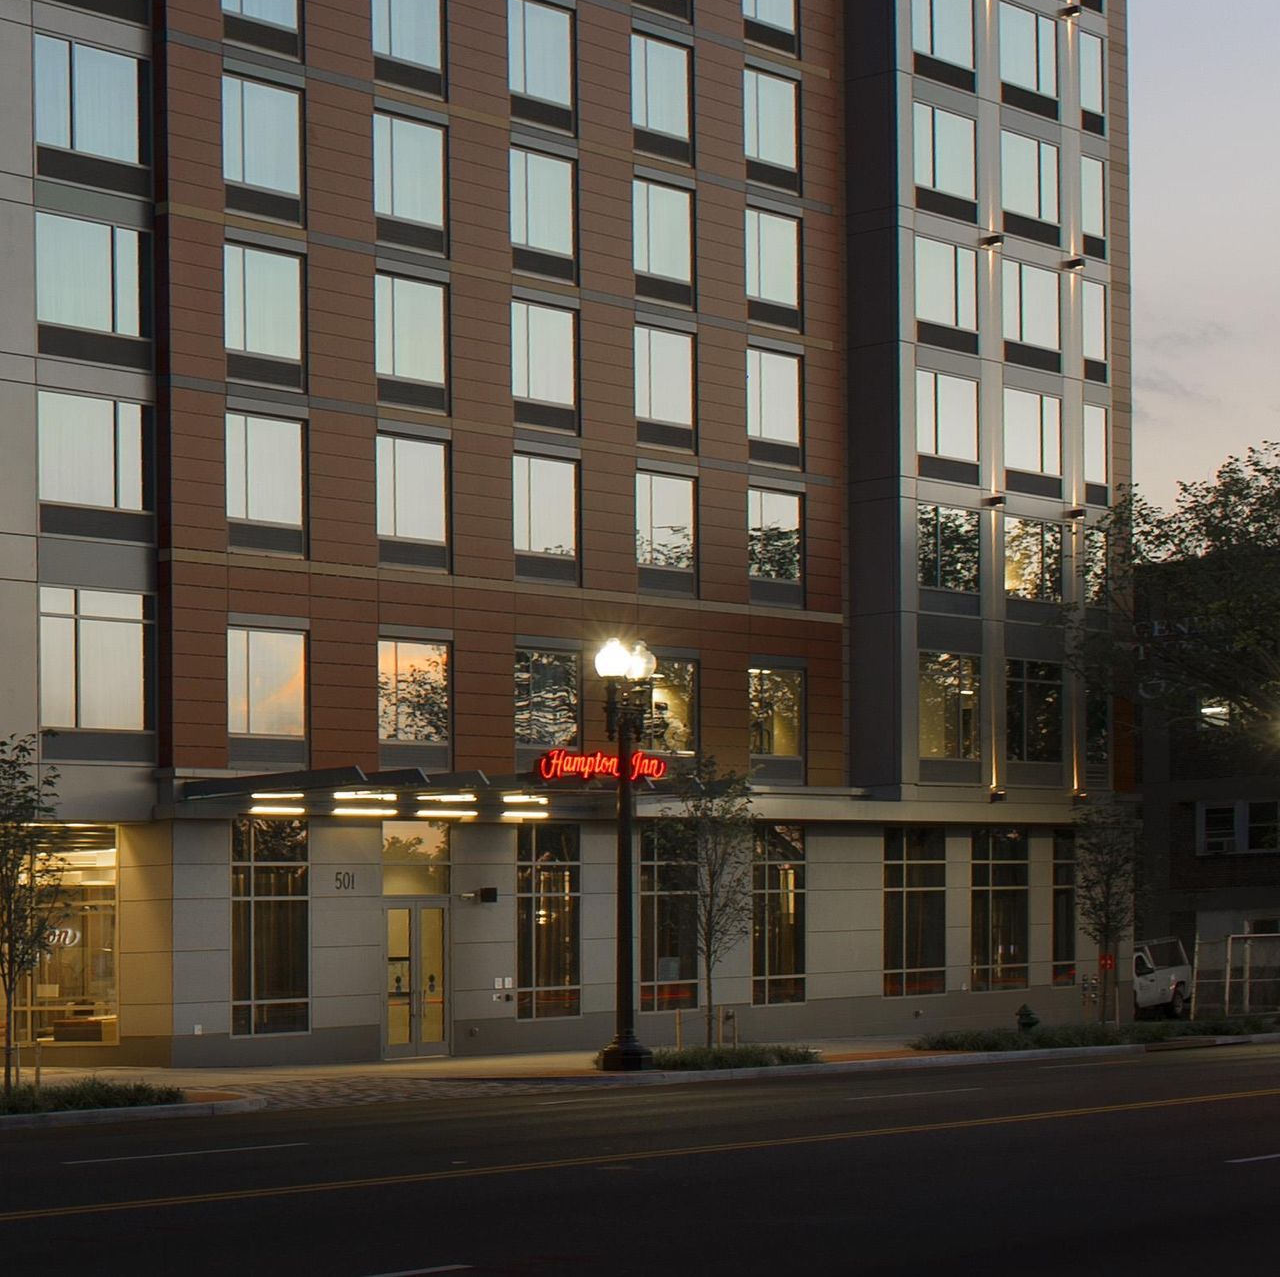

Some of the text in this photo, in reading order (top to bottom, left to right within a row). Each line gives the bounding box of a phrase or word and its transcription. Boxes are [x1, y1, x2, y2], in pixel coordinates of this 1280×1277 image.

[541, 749, 667, 780] Hampton Inn
[335, 871, 355, 890] 501
